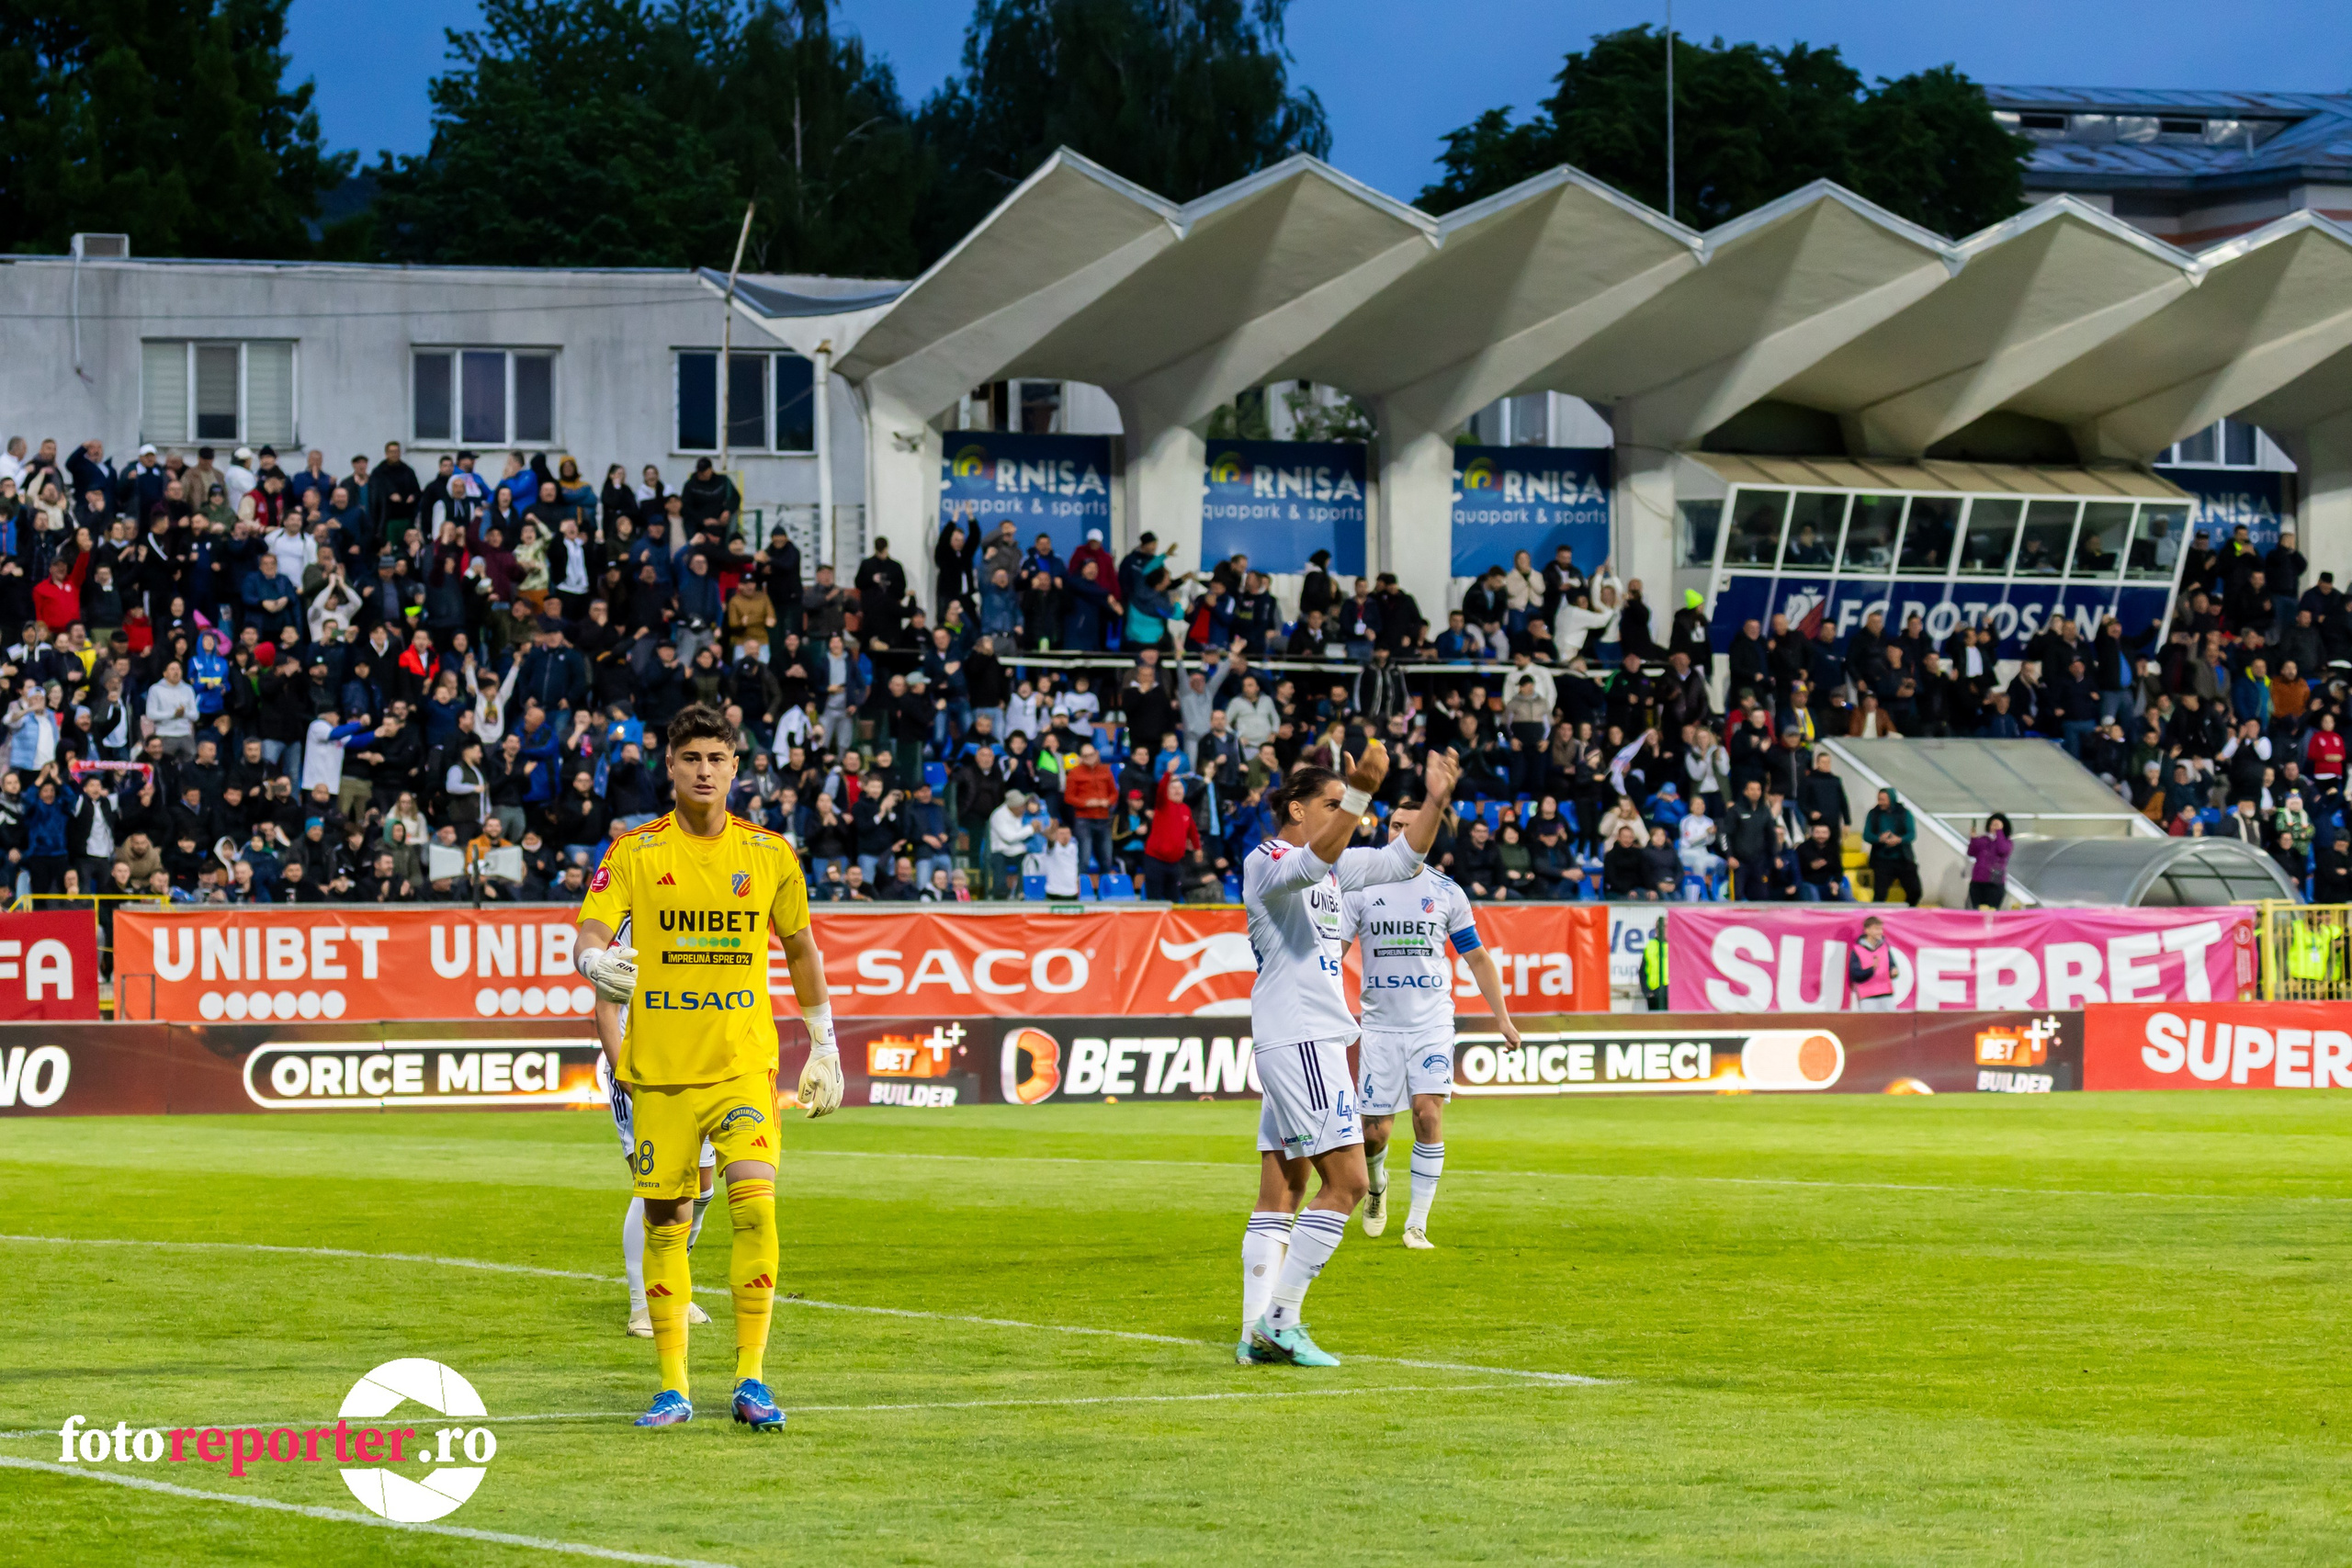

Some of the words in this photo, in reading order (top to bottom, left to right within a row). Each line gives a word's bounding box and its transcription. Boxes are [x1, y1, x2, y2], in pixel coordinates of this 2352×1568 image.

[1051, 499, 1107, 518] sports
[1308, 505, 1363, 524] sports
[1554, 508, 1607, 525] sports
[659, 909, 760, 932] UNIBET
[1370, 920, 1437, 936] UNIBET
[152, 925, 390, 981] UNIBET
[430, 923, 581, 979] UNIB
[712, 954, 735, 964] SPRE
[735, 954, 750, 964] 0%
[1367, 975, 1442, 988] ELSACO
[645, 989, 755, 1010] ELSACO
[1462, 1043, 1596, 1084] ORICE
[1606, 1042, 1712, 1081] MECI
[271, 1053, 424, 1097] ORICE
[437, 1051, 560, 1093] MECI
[1976, 1070, 2053, 1094] BUILDER
[869, 1081, 958, 1108] BUILDER
[637, 1179, 660, 1188] Vestra
